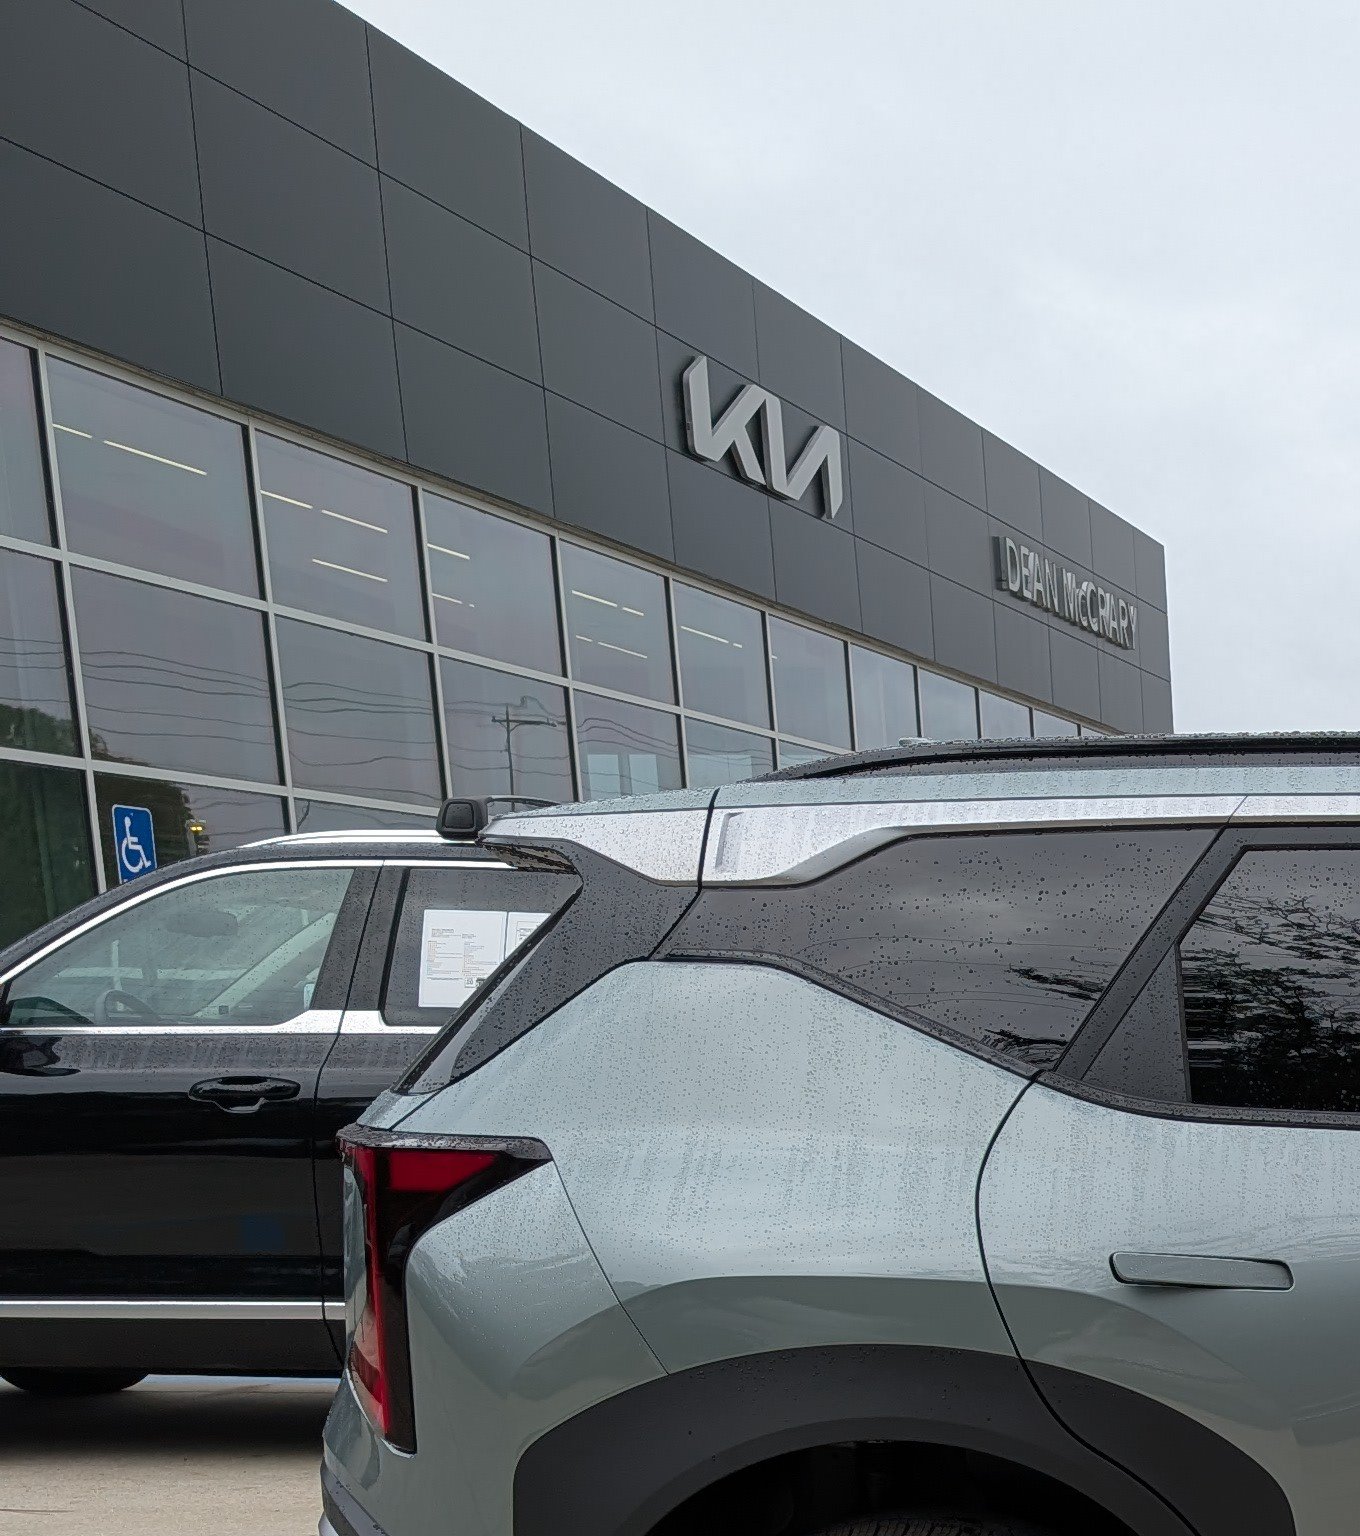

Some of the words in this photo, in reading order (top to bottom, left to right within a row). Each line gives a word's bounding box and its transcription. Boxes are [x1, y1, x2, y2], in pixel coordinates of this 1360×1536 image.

[683, 355, 843, 519] KIA
[995, 536, 1059, 613] DEAN
[1062, 568, 1138, 649] McCRARY
